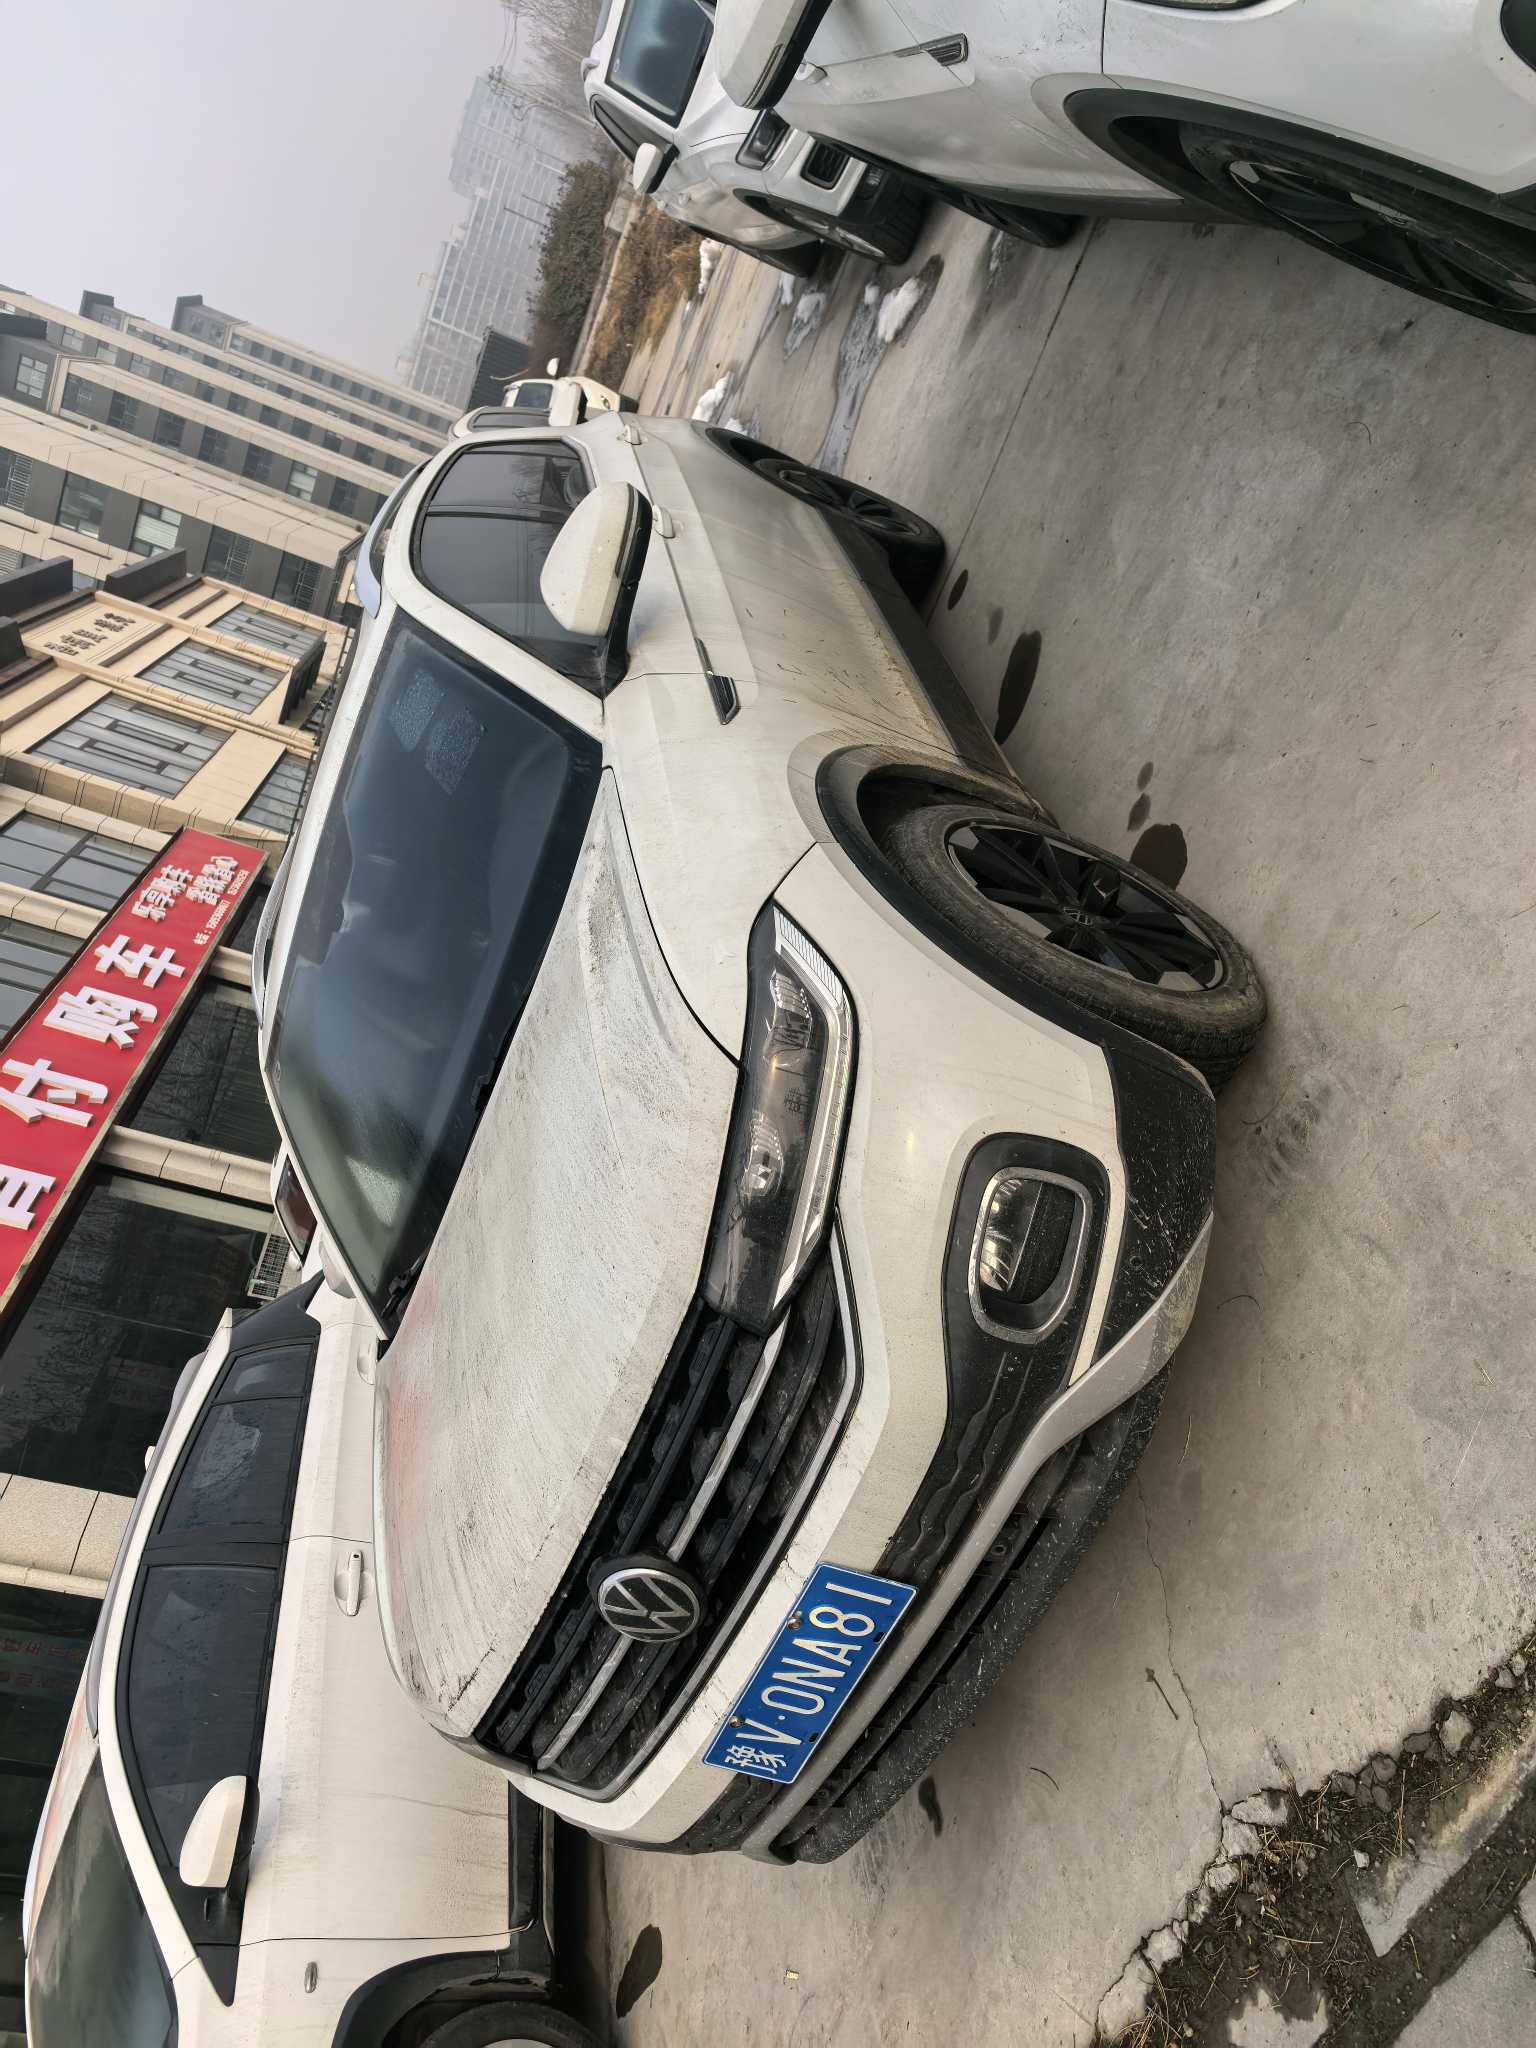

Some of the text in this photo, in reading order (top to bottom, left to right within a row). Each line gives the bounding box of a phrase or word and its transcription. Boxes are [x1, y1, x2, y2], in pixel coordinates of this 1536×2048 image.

[131, 864, 193, 923] 乐享购车
[724, 1582, 893, 1775] 豫V·0NA81
